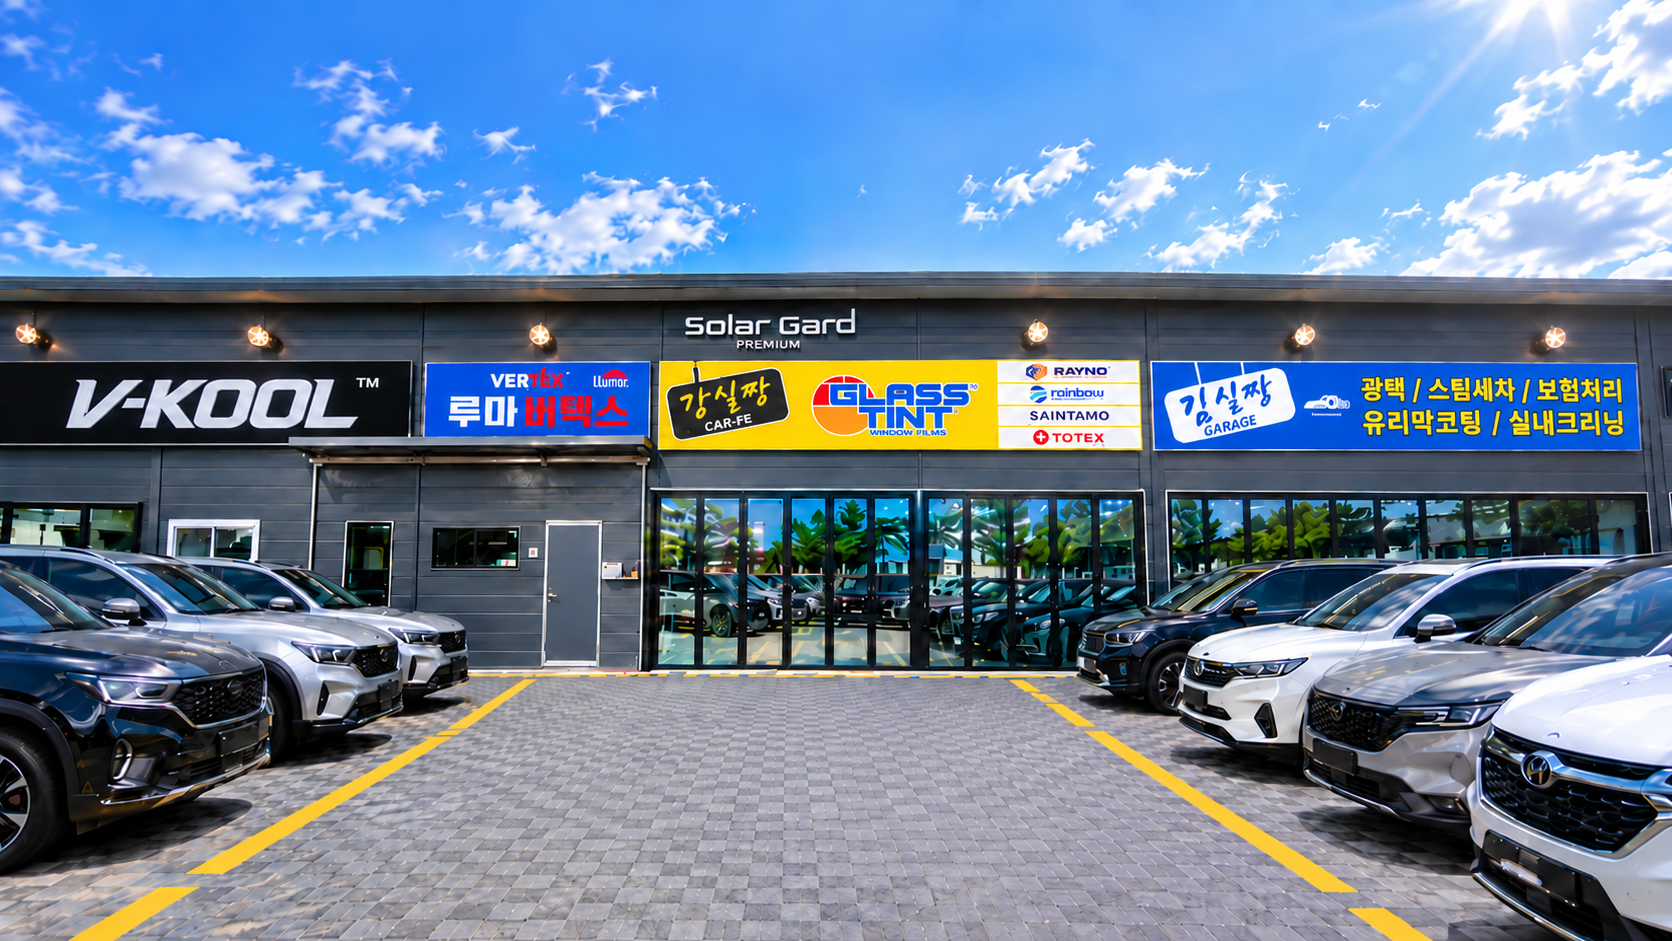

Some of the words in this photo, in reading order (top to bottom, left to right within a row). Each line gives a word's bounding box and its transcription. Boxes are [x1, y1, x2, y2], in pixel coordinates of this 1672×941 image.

[685, 313, 771, 336] Solar
[779, 308, 856, 336] Gard
[736, 339, 801, 350] PREMIUM
[490, 366, 564, 388] VERTEX
[1054, 366, 1108, 376] RAYNO
[679, 375, 771, 420] 강실짱
[829, 383, 971, 407] GLASS
[1050, 387, 1104, 398] rainbow
[1179, 374, 1272, 427] 김실짱
[1360, 376, 1405, 402] 광택
[1412, 378, 1422, 403] /
[1428, 377, 1516, 403] 스팀세차
[1522, 378, 1530, 404] /
[1537, 377, 1623, 403] 보험처리
[66, 378, 358, 429] V-KOOL
[448, 395, 518, 428] 루마
[525, 395, 629, 428] 버텍스
[704, 413, 753, 433] CAR-FE
[858, 406, 954, 429] TINT
[1029, 410, 1110, 421] SAINTAMO
[1204, 415, 1257, 437] GARAGE
[1362, 409, 1481, 436] 유리막코팅
[1492, 410, 1500, 436] /
[1509, 410, 1625, 436] 실내크리닝
[869, 428, 914, 437] WINDOW
[1052, 432, 1105, 443] TOTEX
